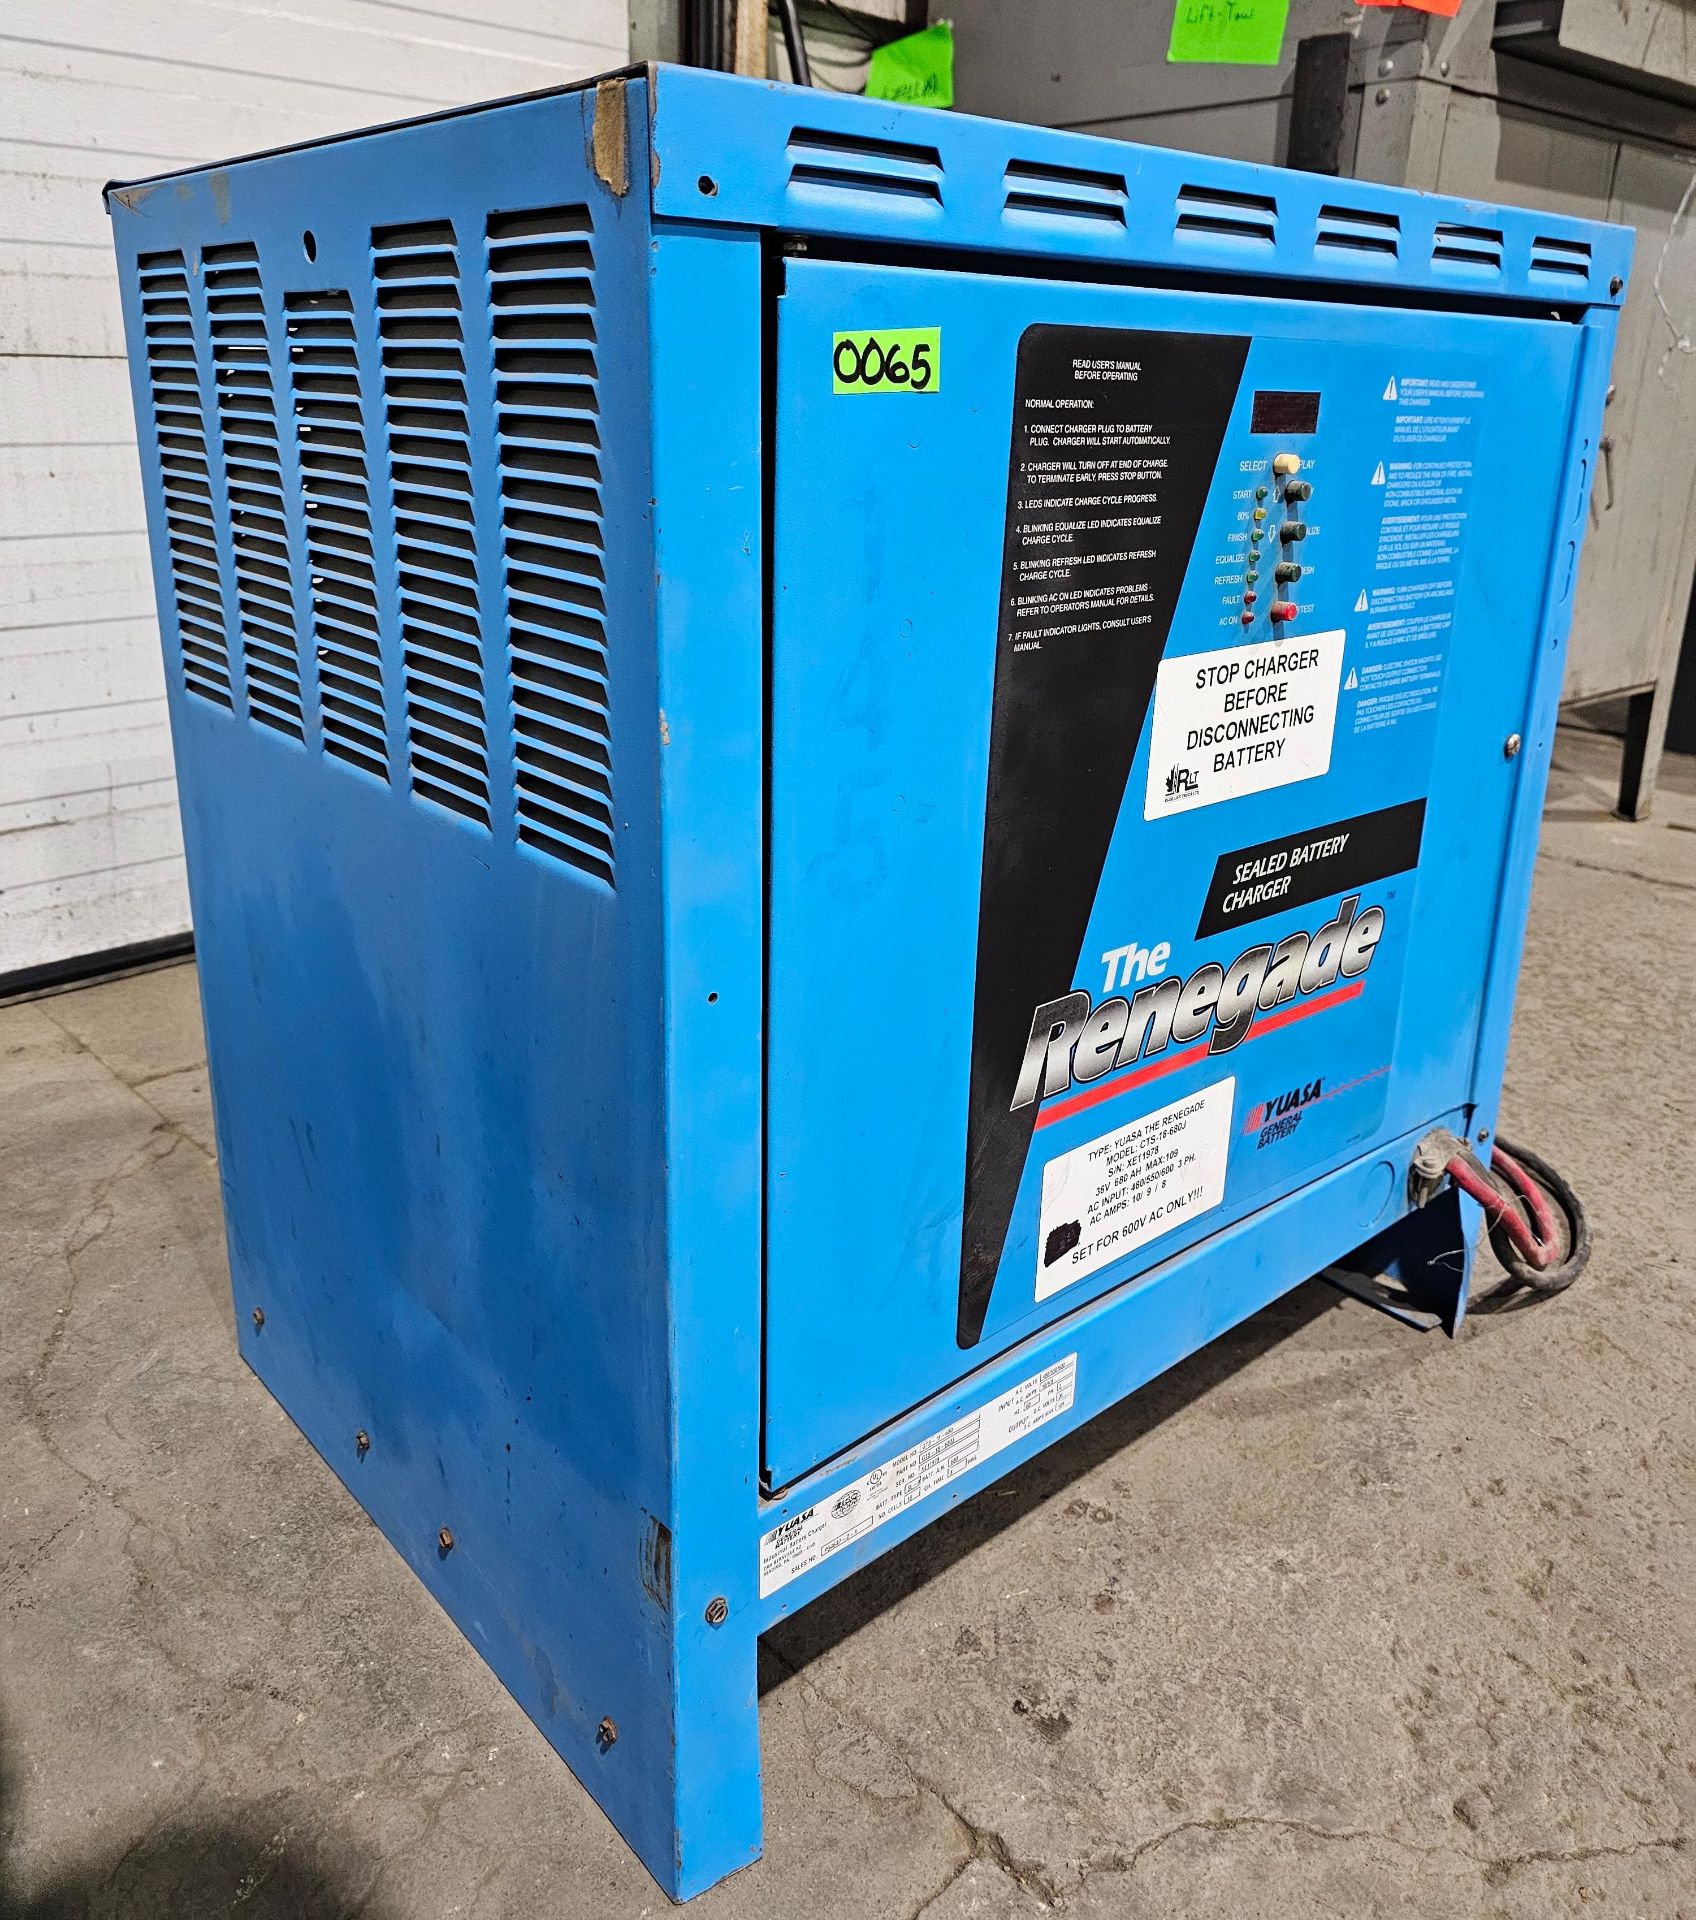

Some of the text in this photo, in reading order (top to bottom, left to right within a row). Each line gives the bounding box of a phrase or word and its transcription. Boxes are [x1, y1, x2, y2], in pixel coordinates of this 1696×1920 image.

[834, 337, 931, 389] 0065
[1073, 360, 1091, 369] READ
[1116, 361, 1141, 371] MANUAL
[1075, 371, 1137, 381] BEFORE OPERATING
[1025, 399, 1094, 409] NORMAL OPERATION:
[1031, 425, 1063, 433] CONNECT
[1065, 425, 1097, 433] CHARGER
[1098, 425, 1114, 433] PLUG
[1116, 425, 1124, 433] TO
[1125, 425, 1152, 433] BATTERY
[1030, 436, 1170, 446] PLUG. CHARGER WILL START AUTOMATICALLY.
[1021, 460, 1168, 471] 2. CHARGER WILL TURN OFF AT END OF CHARGE.
[1240, 461, 1267, 471] SELECT
[1027, 471, 1162, 483] TO TERMINATE EARLY, PRESS STOP BUTTON.
[1018, 494, 1157, 509] 3. LEDS INDICATE CHARGE CYCLE PROGRESS.
[1233, 490, 1251, 499] START
[1016, 516, 1161, 534] 4. BLINKING EQUALIZE LED INDICATES EQUALIZE
[1022, 536, 1050, 545] CHARGE
[1228, 532, 1247, 541] FINISH
[1020, 559, 1050, 570] BLINKING
[1052, 556, 1082, 567] REFRESH
[1083, 555, 1095, 564] LED
[1097, 553, 1127, 563] INDICATES
[1129, 550, 1156, 561] REFRESH
[1216, 554, 1245, 564] EQUALIZE
[1020, 571, 1047, 581] CHARGE
[1215, 575, 1242, 585] REFRESH
[1011, 584, 1148, 606] 6. BLINKING AC ON LED INDICATES PROBLEMS
[1017, 606, 1039, 617] REFER
[1040, 605, 1048, 614] TO
[1091, 598, 1115, 608] MANUAL
[1116, 597, 1128, 606] FOR
[1130, 594, 1154, 604] DETAILS.
[1222, 595, 1240, 604] FAULT
[1015, 632, 1021, 640] IF
[1022, 629, 1042, 639] FAULT
[1044, 625, 1076, 637] INDICATOR
[1078, 622, 1101, 632] LIGHTS,
[1102, 618, 1129, 629] CONSULT
[1196, 649, 1318, 689] STOP CHARGER
[1224, 683, 1287, 712] BEFORE
[1187, 705, 1314, 750] DISCONNECTING
[1213, 739, 1285, 772] BATTERY
[1232, 833, 1349, 885] SEALED BATTERY
[1222, 876, 1292, 913] CHARGER
[1101, 941, 1171, 993] The
[1010, 893, 1385, 1111] Renegade
[1264, 1078, 1322, 1122] YUASA
[1088, 1100, 1205, 1162] TYPE: YUASA THE RENEGADE
[1260, 1111, 1303, 1138] GENERAL
[1257, 1123, 1300, 1150] BATTERY
[1106, 1145, 1138, 1166] MODEL:
[1108, 1146, 1159, 1178] S/N: XE11978
[1115, 1173, 1129, 1186] 680
[1130, 1167, 1141, 1180] AH
[1088, 1201, 1099, 1215] AC
[1102, 1188, 1129, 1209] INPUT:
[1178, 1160, 1182, 1169] 3
[1090, 1213, 1101, 1226] AC
[1104, 1199, 1129, 1220] AMPS:
[1147, 1188, 1152, 1197] 9
[1162, 1180, 1166, 1189] 8
[1072, 1186, 1203, 1265] SET FOR 600V AC ONLY!!!
[777, 1507, 814, 1537] YUASA
[791, 1559, 806, 1574] SALES
